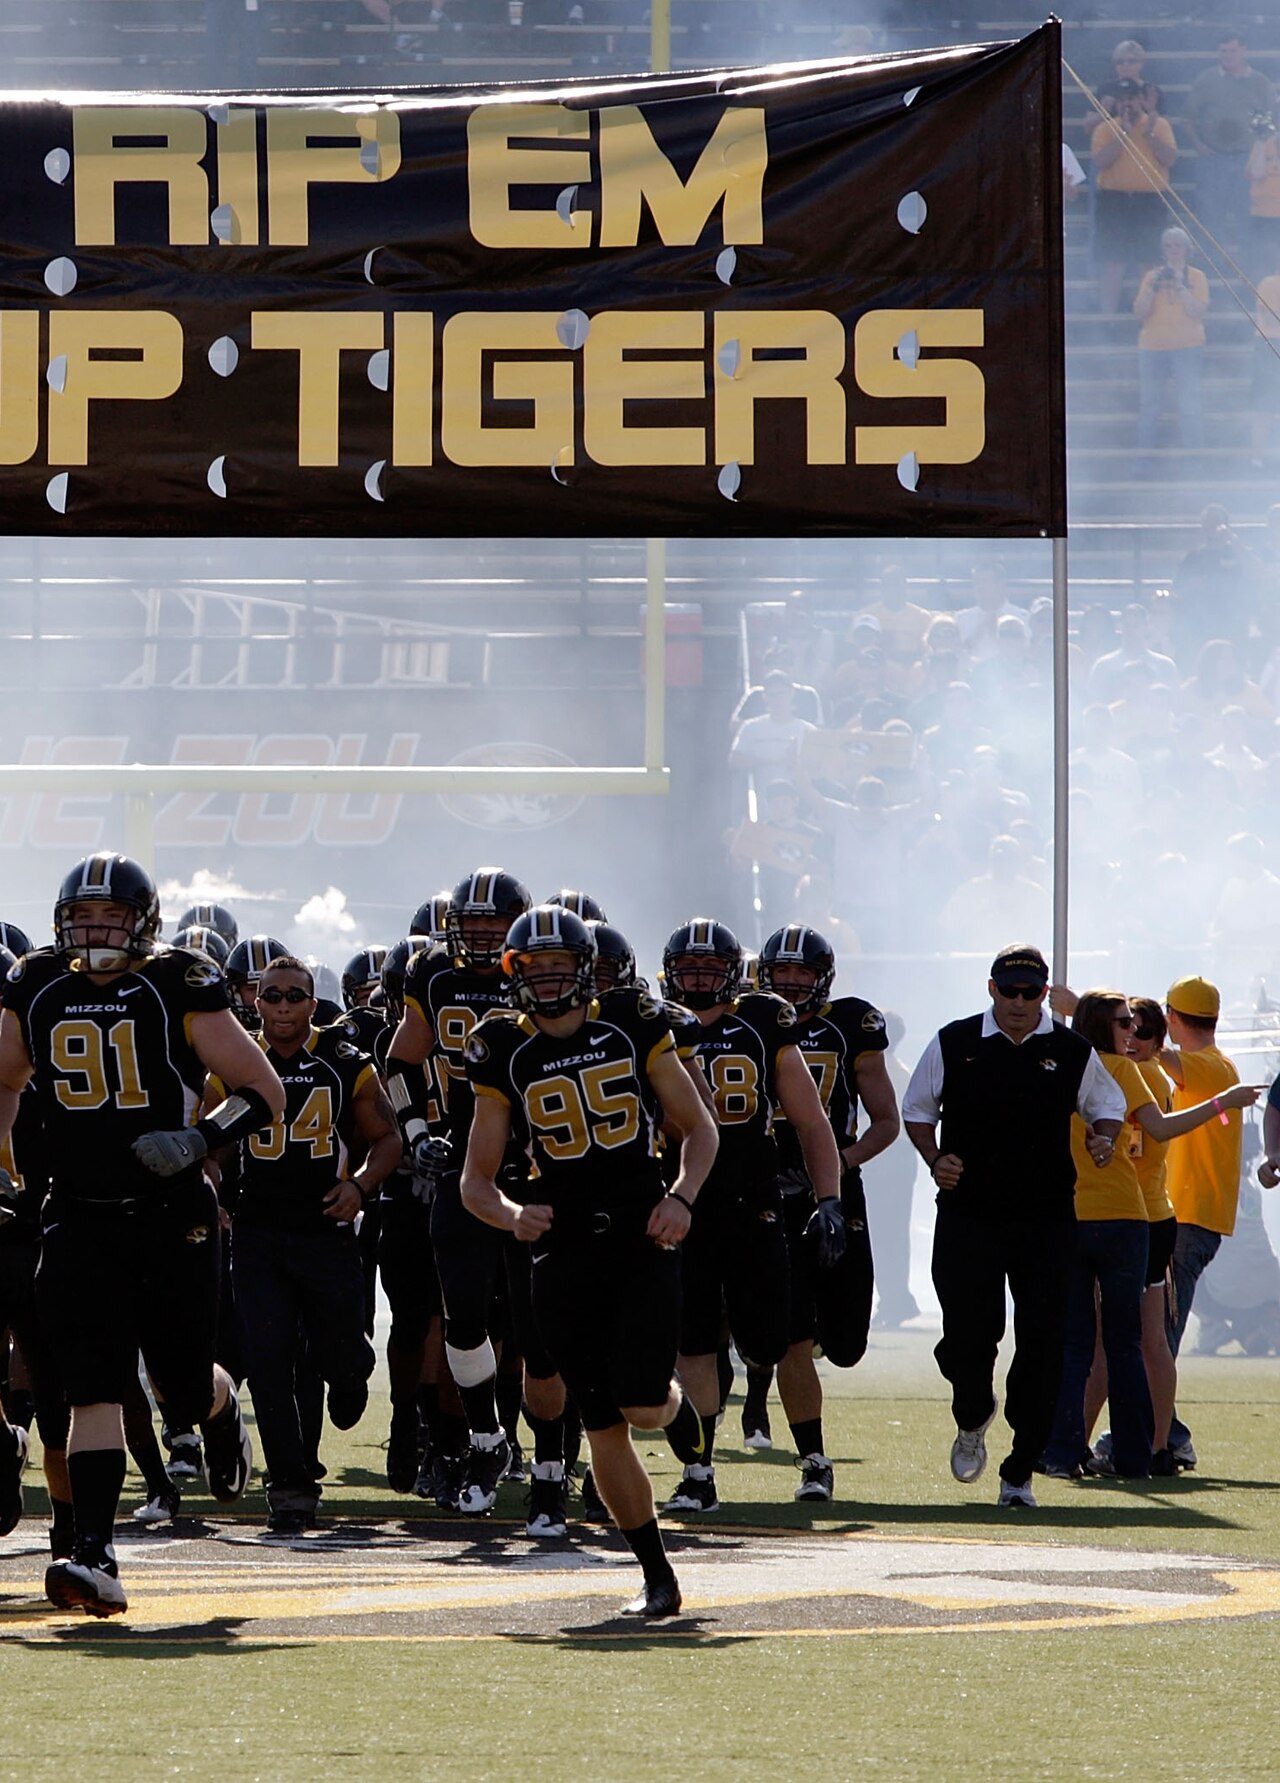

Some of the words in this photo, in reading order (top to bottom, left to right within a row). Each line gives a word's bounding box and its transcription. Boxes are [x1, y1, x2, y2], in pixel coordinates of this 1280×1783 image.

[73, 108, 401, 246] RIP
[467, 105, 768, 249] EM
[251, 309, 986, 466] TIGERS
[154, 732, 421, 847] ZOU
[65, 1004, 128, 1014] MIZZOU
[454, 993, 509, 1004] MIZZOU
[1005, 959, 1041, 969] MIZZOU
[50, 1019, 151, 1111] 91
[542, 1050, 607, 1073] MIZZOU
[523, 1056, 641, 1161] 95
